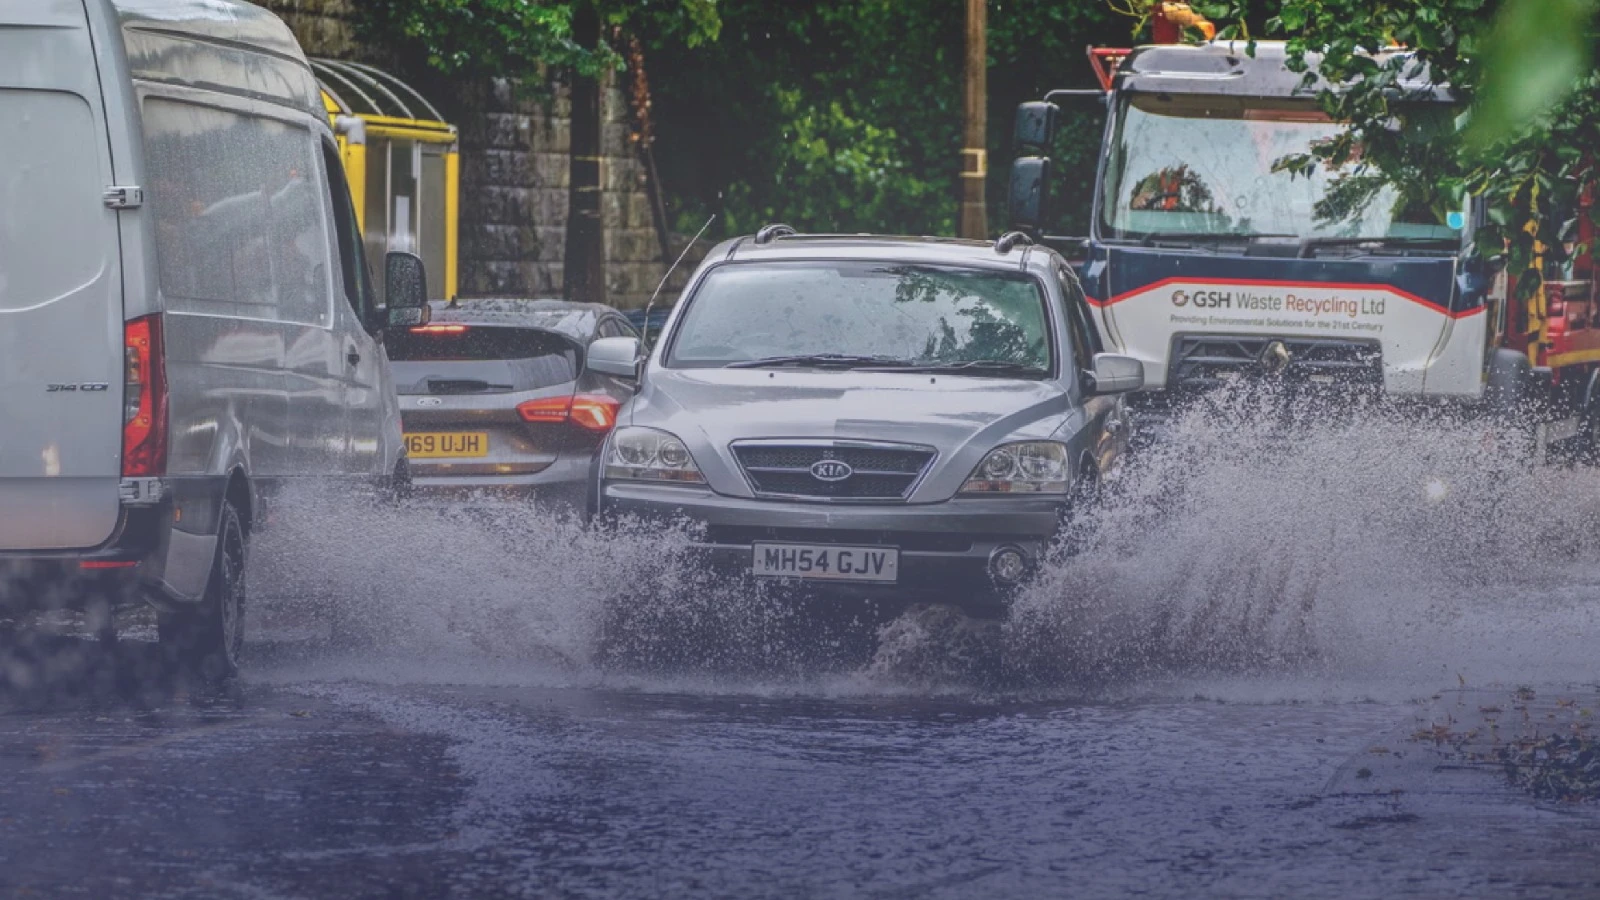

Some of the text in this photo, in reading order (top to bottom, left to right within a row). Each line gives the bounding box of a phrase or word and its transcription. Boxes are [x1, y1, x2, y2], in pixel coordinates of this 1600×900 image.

[1193, 291, 1385, 318] GSH Waste Recycling Ltd
[1170, 314, 1384, 332] Providing Environmental Solutions for the 21st Century
[441, 435, 479, 452] UJH
[818, 464, 845, 476] KIA
[764, 548, 885, 575] MH54 GJV
